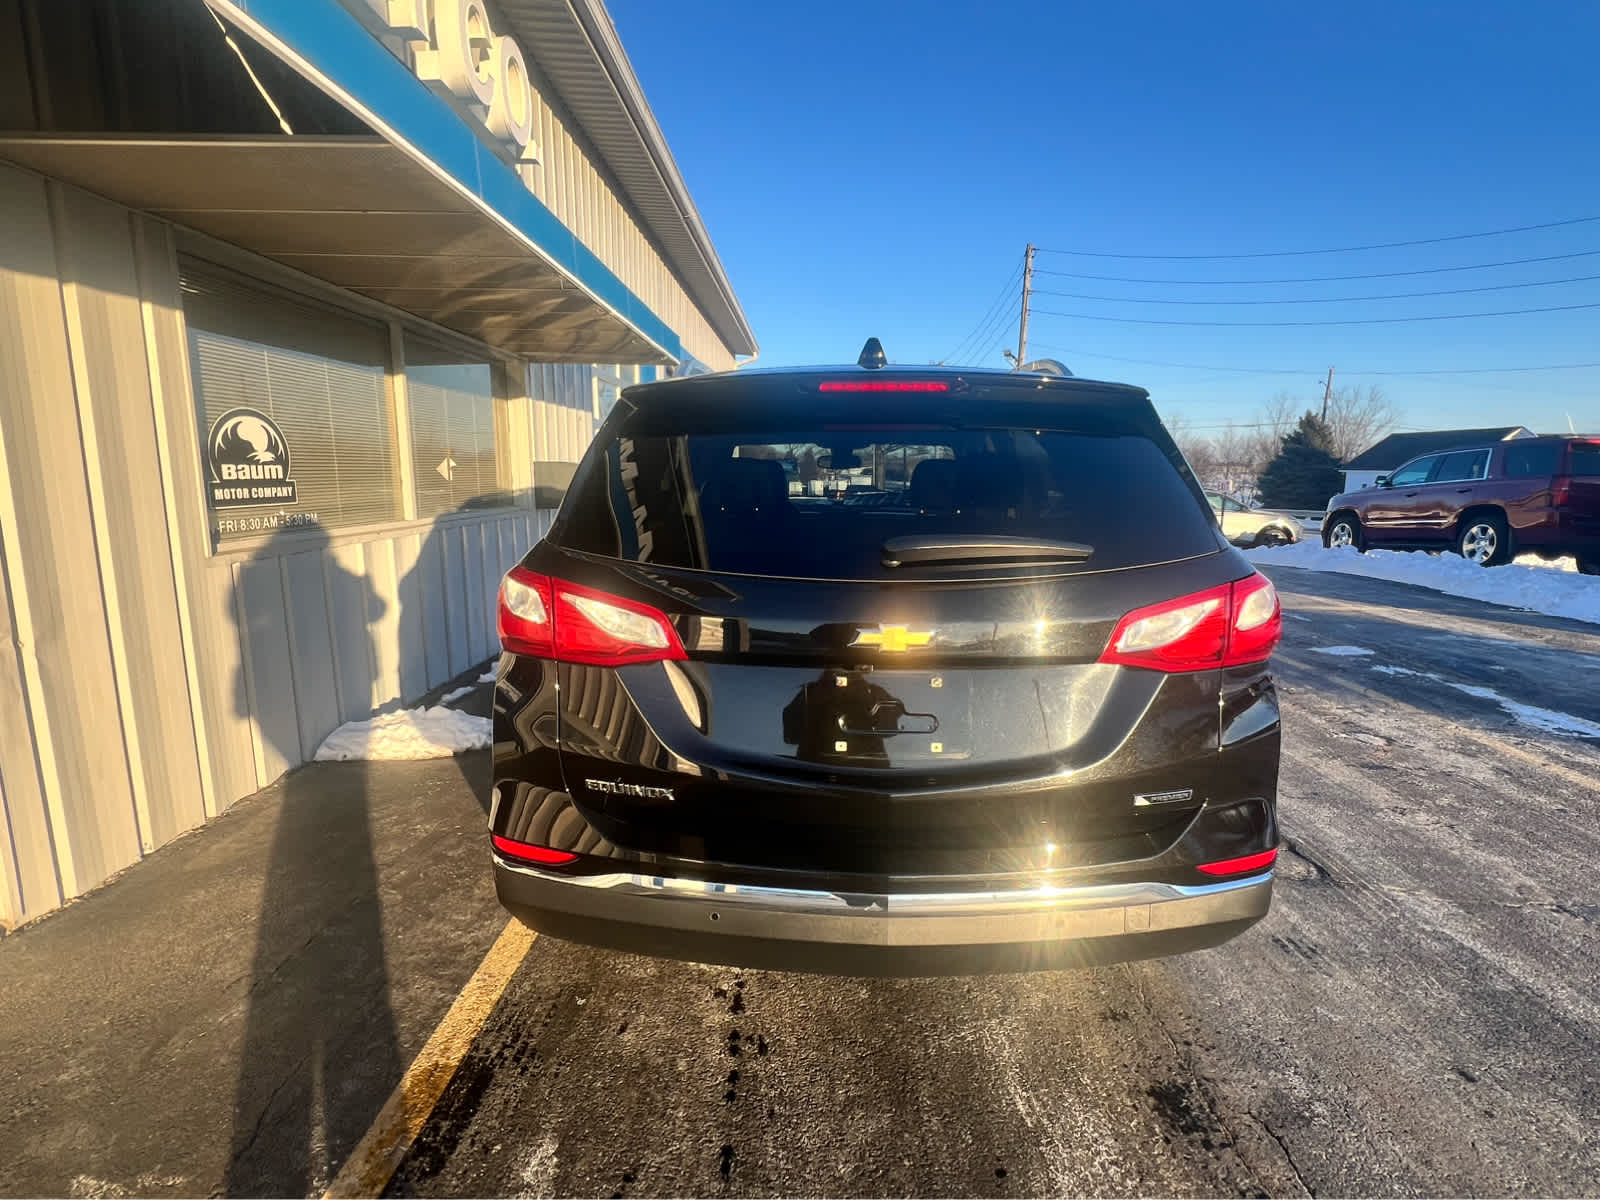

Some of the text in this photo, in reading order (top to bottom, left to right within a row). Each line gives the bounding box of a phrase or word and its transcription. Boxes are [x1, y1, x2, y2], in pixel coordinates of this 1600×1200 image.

[221, 463, 284, 480] Baum
[214, 486, 293, 501] MOTOR COMPANY
[240, 518, 261, 530] 8:30
[263, 516, 278, 528] AM
[305, 513, 319, 525] PM
